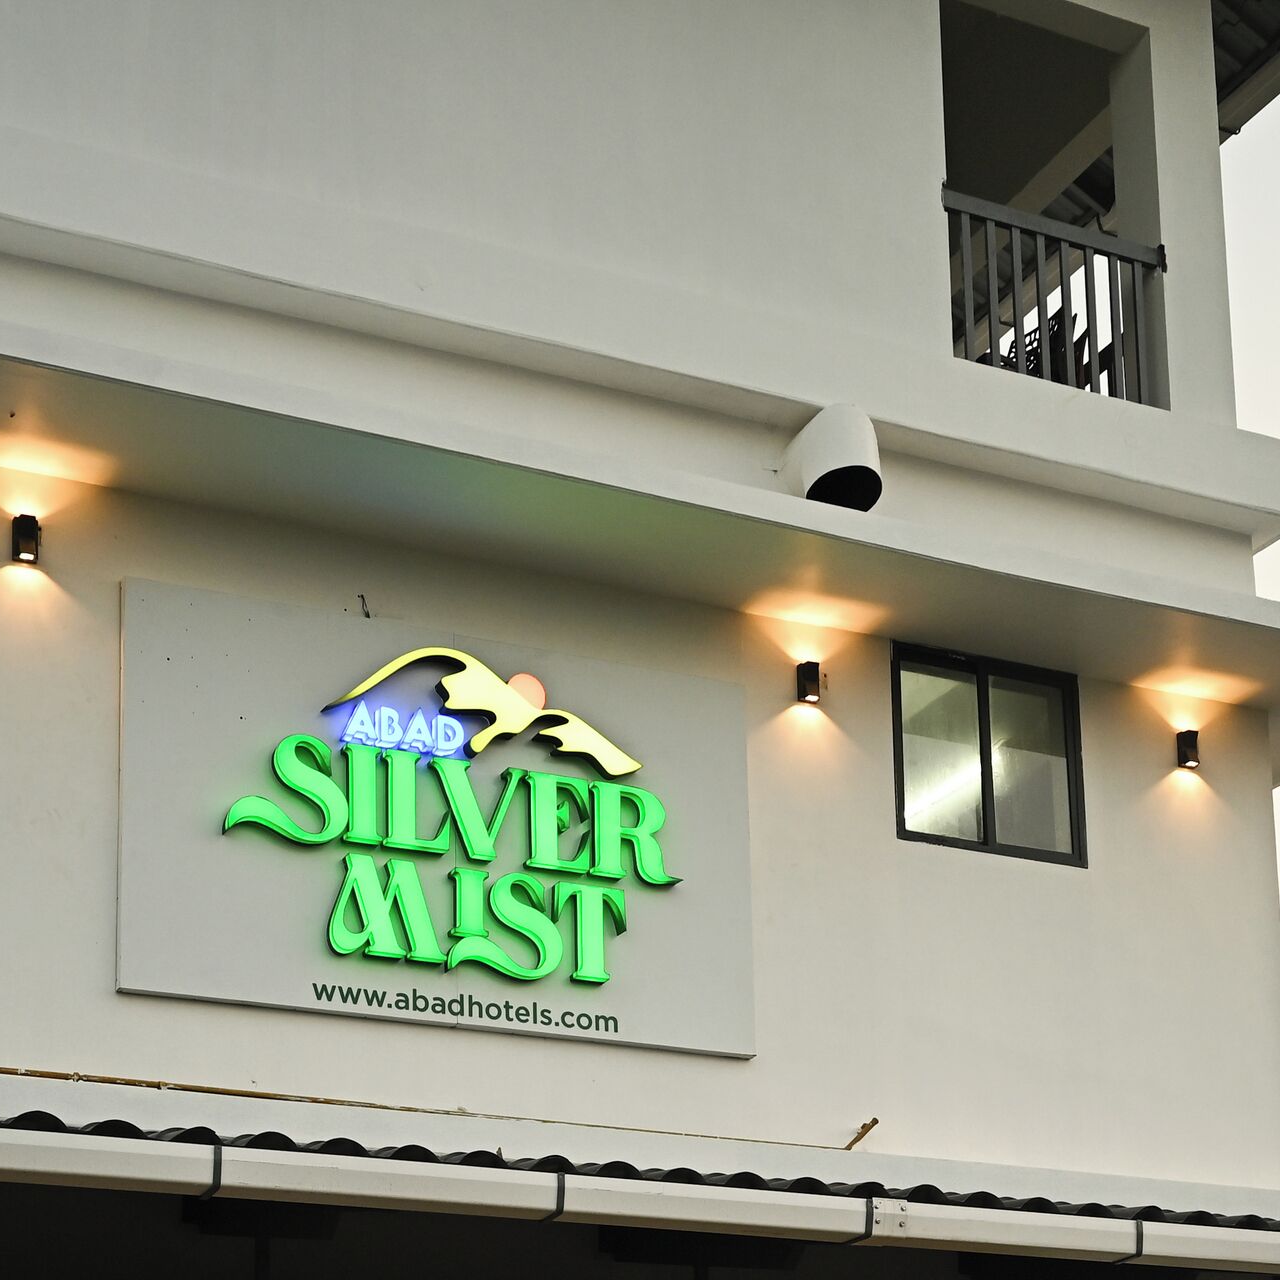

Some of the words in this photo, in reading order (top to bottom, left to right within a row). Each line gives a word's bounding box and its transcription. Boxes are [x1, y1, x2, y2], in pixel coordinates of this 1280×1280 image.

[340, 700, 465, 756] ABAD
[223, 733, 683, 886] SILVER
[327, 853, 627, 984] MIST
[312, 982, 619, 1033] www.abadhotels.com
